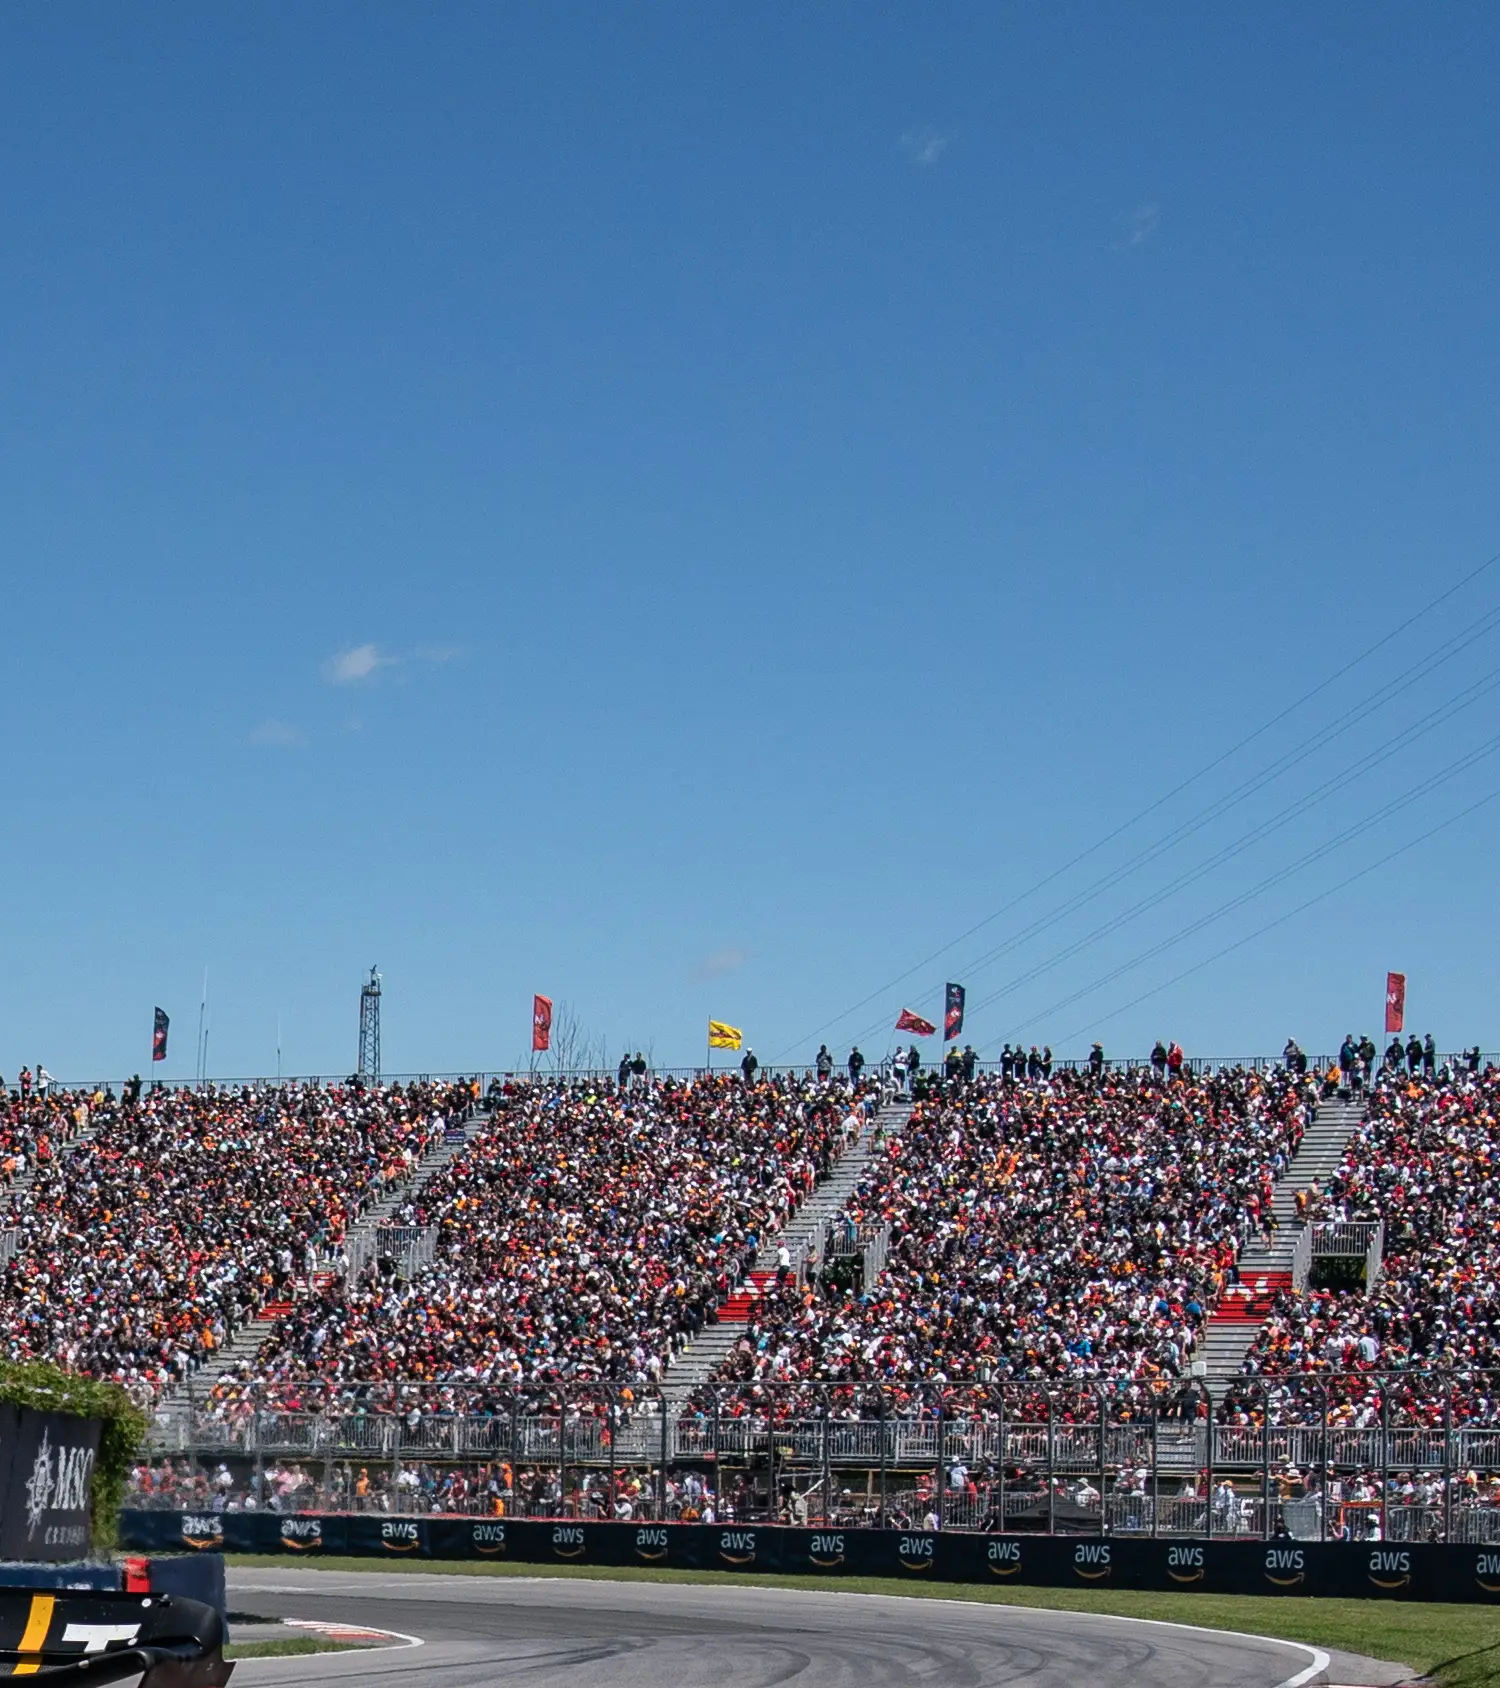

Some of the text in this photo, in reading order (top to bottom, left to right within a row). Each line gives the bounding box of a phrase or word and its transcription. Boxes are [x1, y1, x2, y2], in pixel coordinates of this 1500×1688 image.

[50, 1445, 95, 1511] MSC
[381, 1522, 418, 1540] aws
[472, 1524, 505, 1542] aws
[552, 1526, 585, 1544] aws
[636, 1528, 668, 1547] aws
[720, 1531, 756, 1550] aws
[810, 1534, 845, 1553] aws
[898, 1536, 934, 1556] aws
[987, 1541, 1021, 1561] aws
[1074, 1543, 1111, 1564] aws
[1167, 1546, 1204, 1567] aws
[1265, 1549, 1305, 1570] aws
[1369, 1550, 1410, 1572] aws
